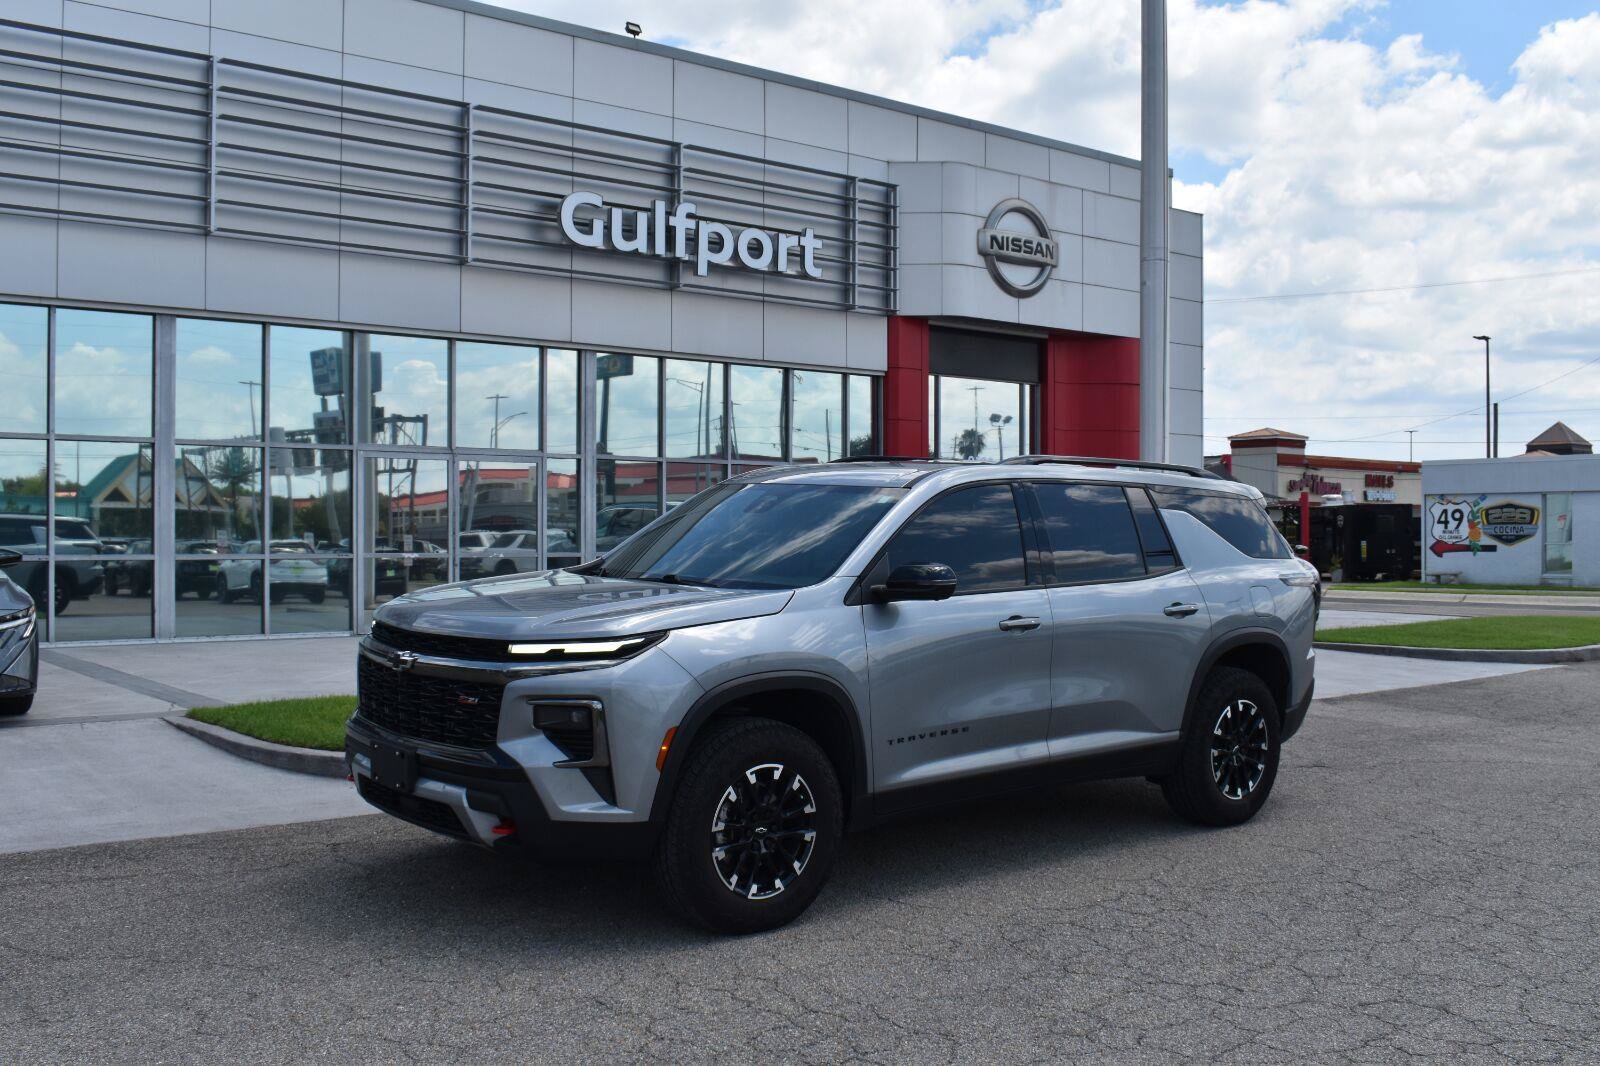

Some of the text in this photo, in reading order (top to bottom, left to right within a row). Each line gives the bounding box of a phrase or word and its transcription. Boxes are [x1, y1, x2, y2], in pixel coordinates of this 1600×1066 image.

[559, 191, 824, 279] Gulfport
[990, 234, 1054, 260] NISSAN
[1436, 508, 1465, 530] 49
[1493, 525, 1525, 534] COCINA
[887, 726, 970, 745] TRAVERSE
